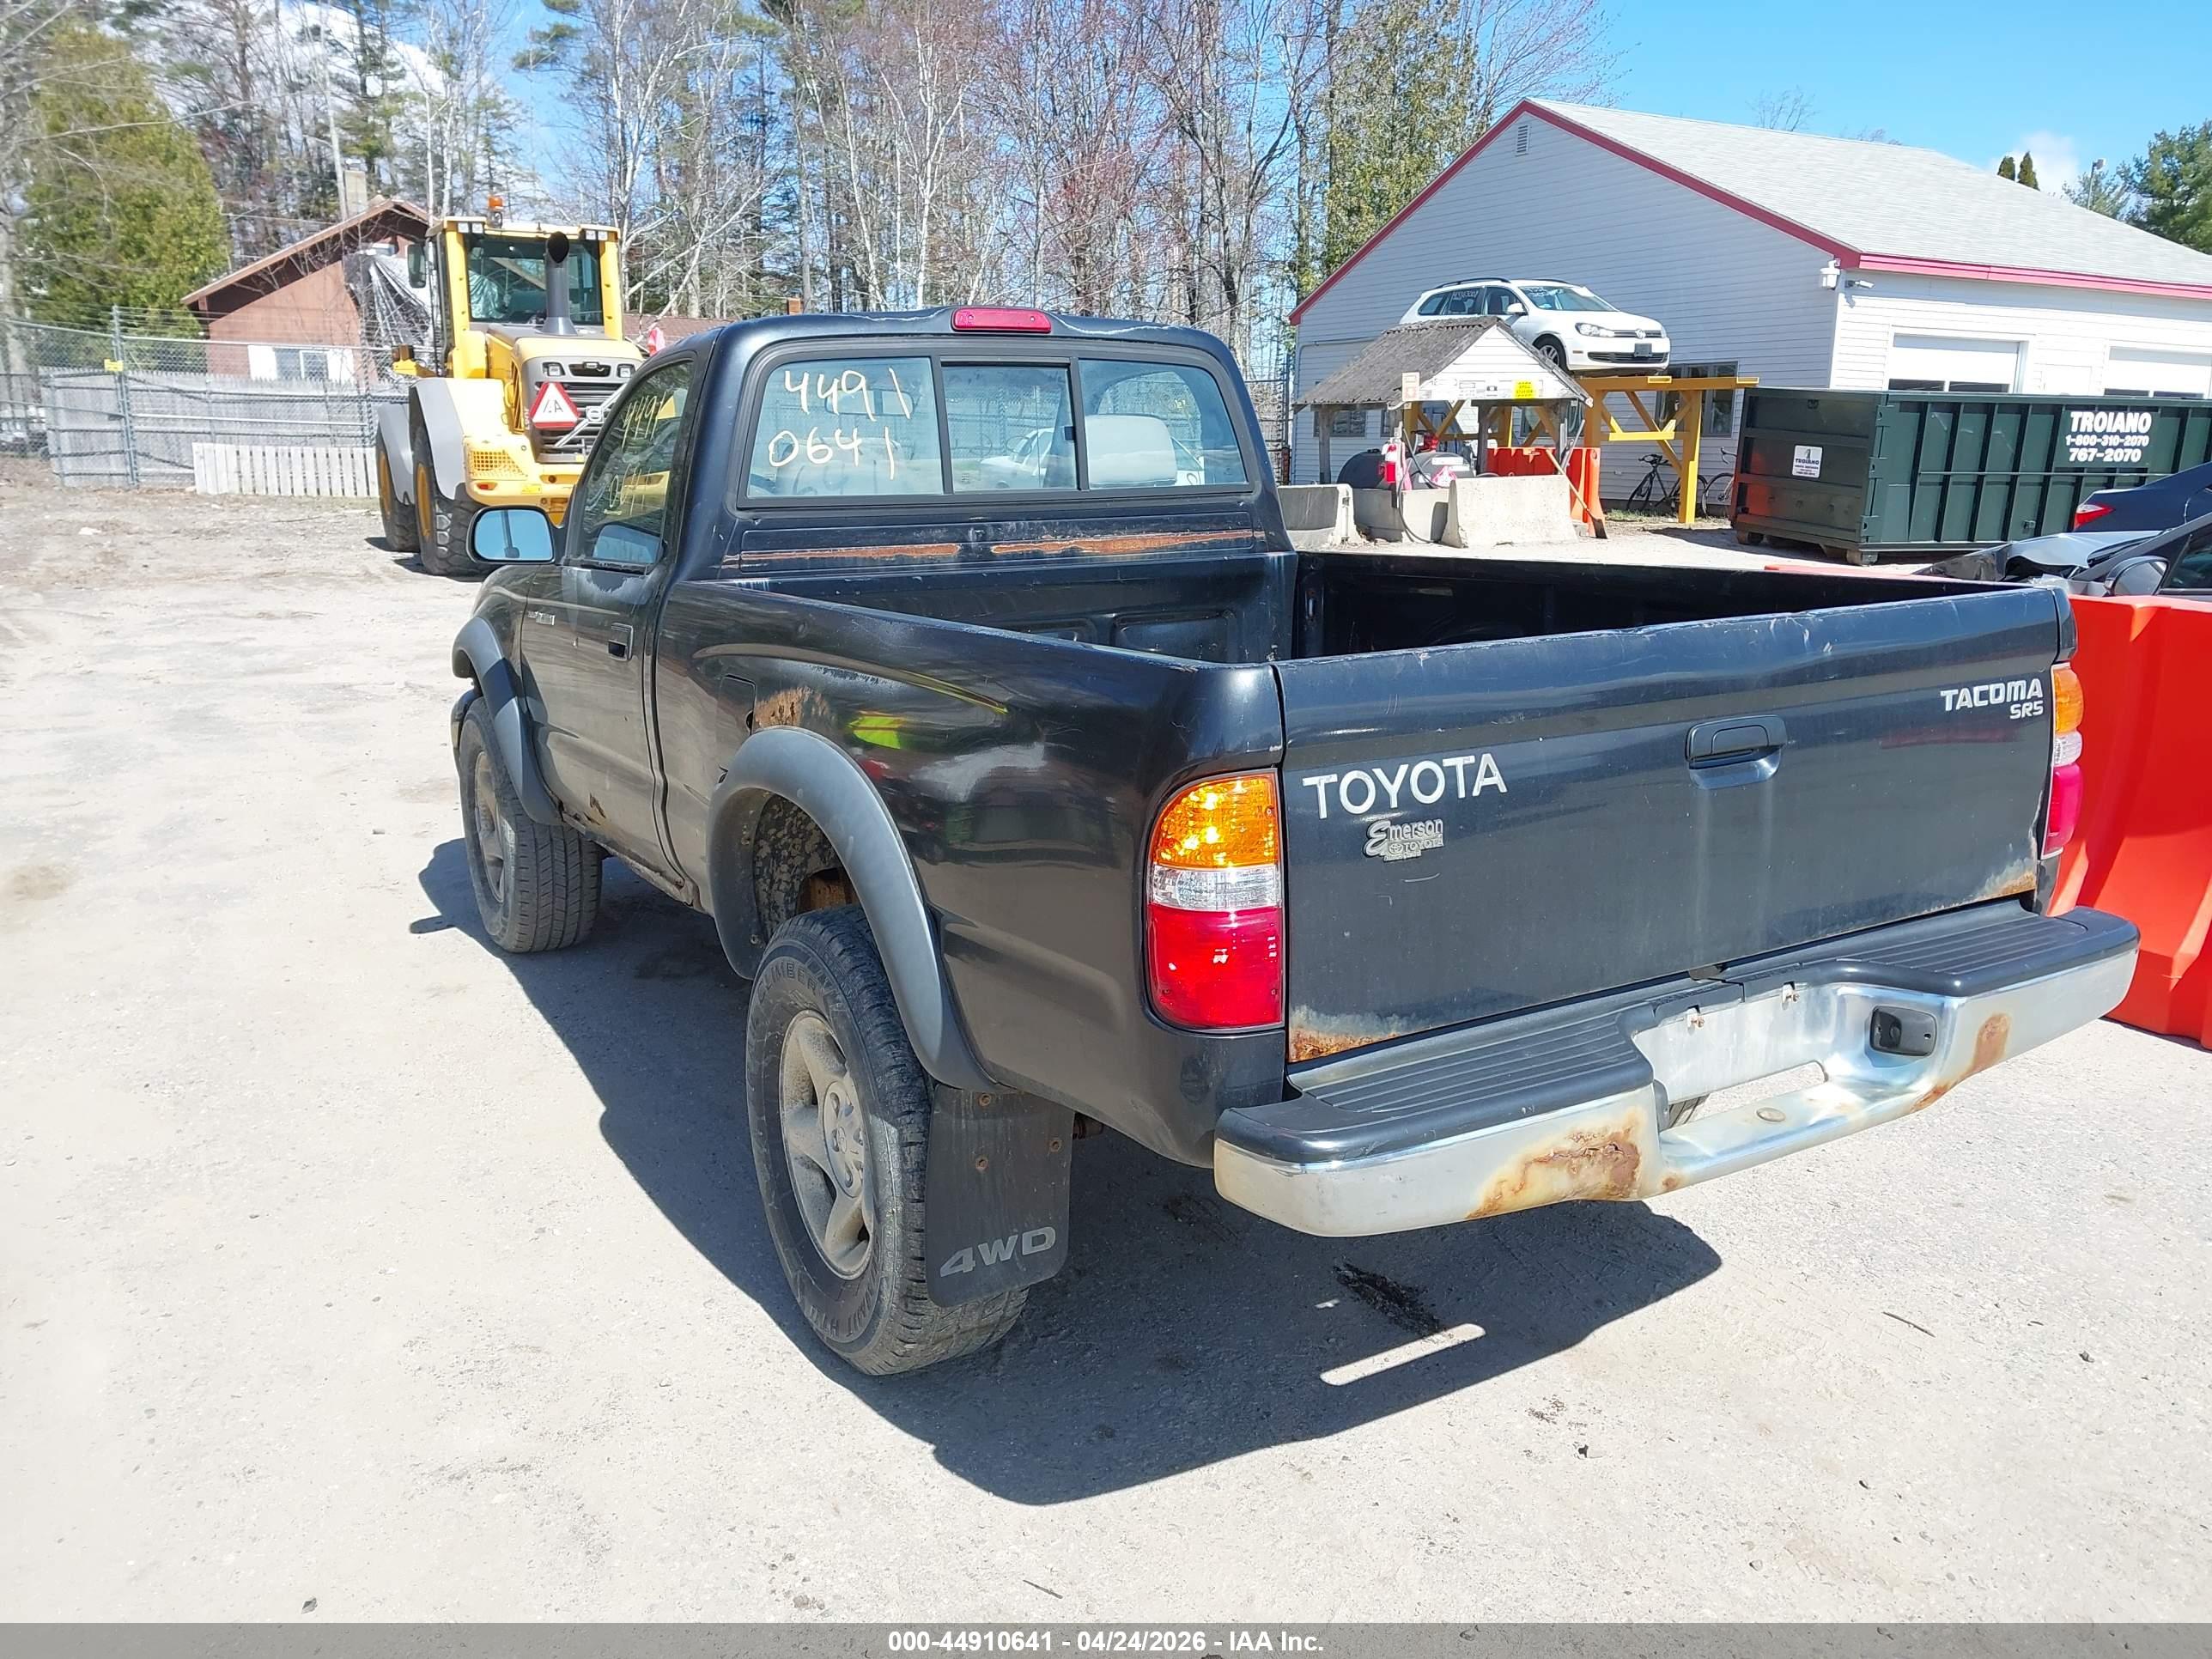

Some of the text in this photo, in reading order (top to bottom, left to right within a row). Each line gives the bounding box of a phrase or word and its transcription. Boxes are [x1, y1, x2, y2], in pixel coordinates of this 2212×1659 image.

[2070, 411, 2152, 434] TROIANO
[769, 426, 895, 480] 0641
[2065, 434, 2149, 447] 1-800-310-2070
[2069, 447, 2142, 462] 767-2070
[1940, 678, 2044, 712] TACOMA
[2009, 700, 2044, 720] SR5
[1303, 752, 1508, 819] TOYOTA
[1364, 818, 1443, 857] Emerson
[1404, 834, 1444, 852] TOYOTA
[939, 1226, 1056, 1278] 4WD
